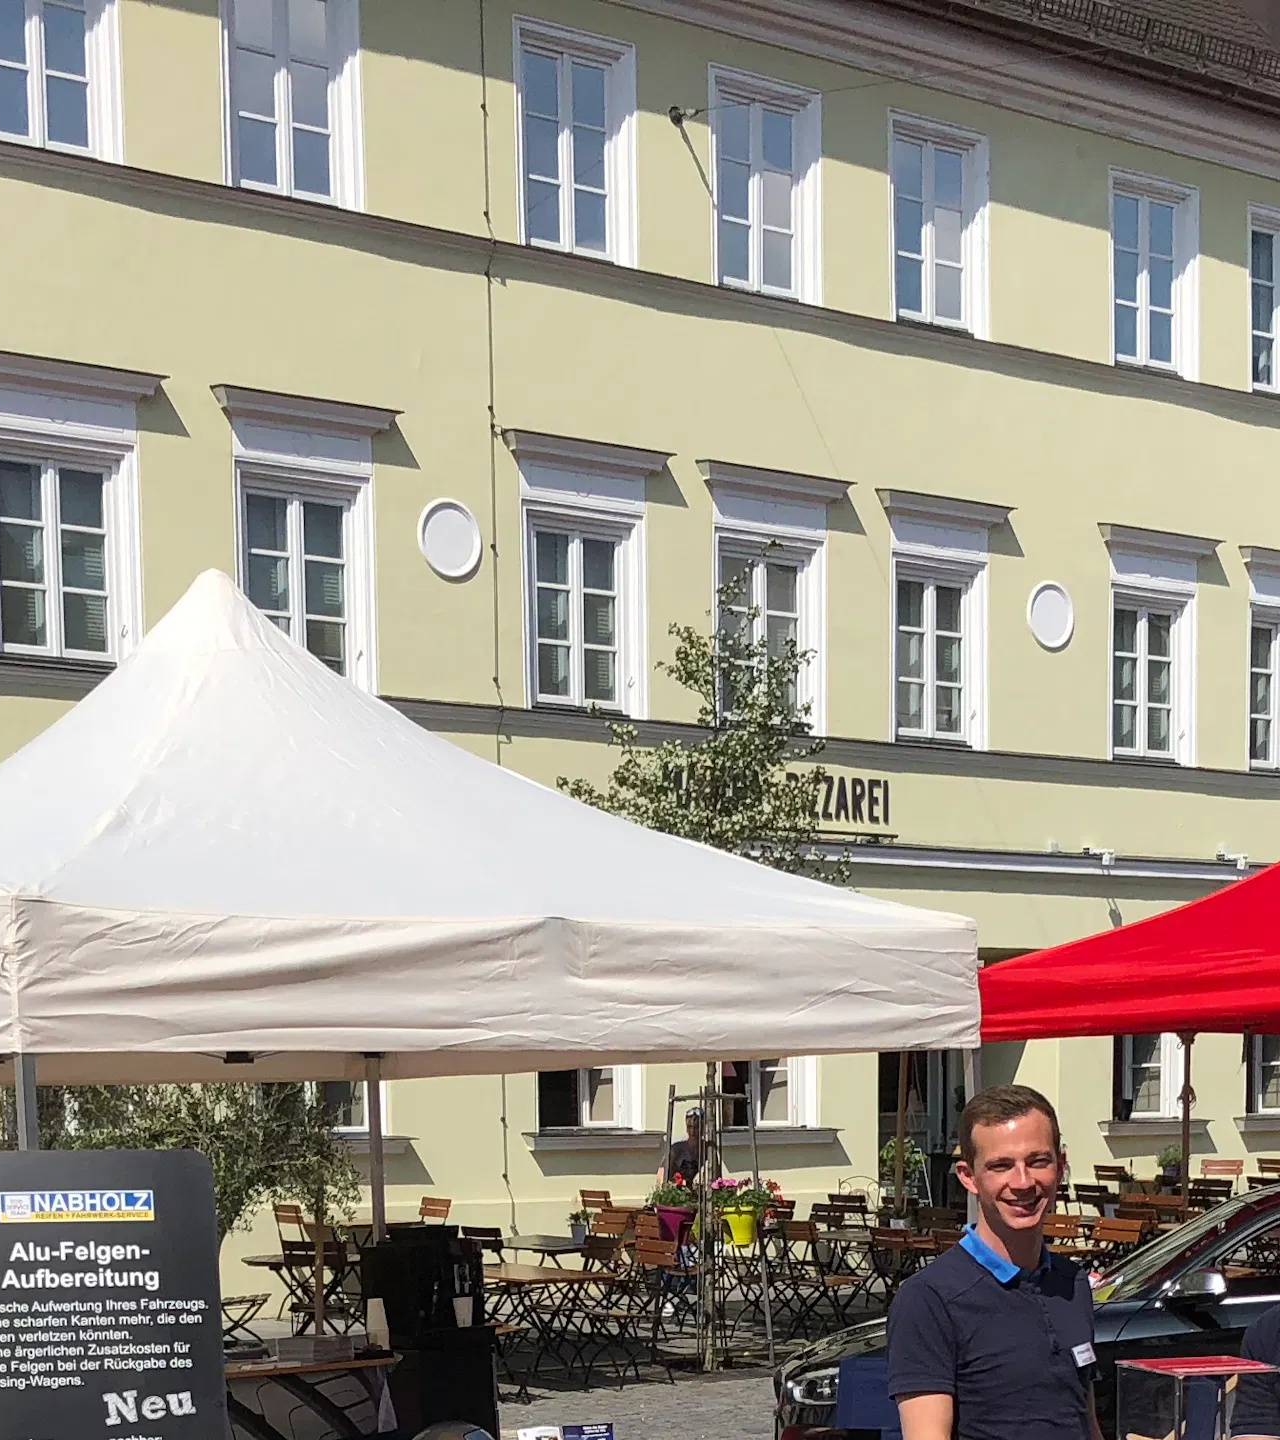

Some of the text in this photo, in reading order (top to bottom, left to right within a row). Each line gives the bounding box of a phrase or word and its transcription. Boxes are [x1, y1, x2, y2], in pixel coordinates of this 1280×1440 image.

[34, 1193, 150, 1212] NABHOLZ
[9, 1241, 151, 1265] Alu-Felgen-
[1, 1268, 160, 1291] Aufbereitung
[31, 1301, 103, 1315] Aufwertung
[106, 1299, 137, 1311] Ihres
[140, 1298, 209, 1313] Fahrzeugs.
[13, 1315, 68, 1328] scharfen
[71, 1315, 116, 1327] Kanten
[119, 1314, 154, 1327] mehr,
[157, 1313, 176, 1325] die
[179, 1312, 203, 1325] den
[18, 1330, 76, 1342] verletzen
[79, 1328, 133, 1341] könnten.
[14, 1344, 85, 1360] ärgerlichen
[87, 1342, 171, 1356] Zusatzkosten
[173, 1341, 191, 1354] für
[11, 1360, 54, 1375] Felgen
[57, 1359, 77, 1372] bei
[80, 1359, 101, 1371] der
[104, 1357, 167, 1373] Rückgabe
[169, 1357, 193, 1369] des
[102, 1389, 197, 1427] Neu
